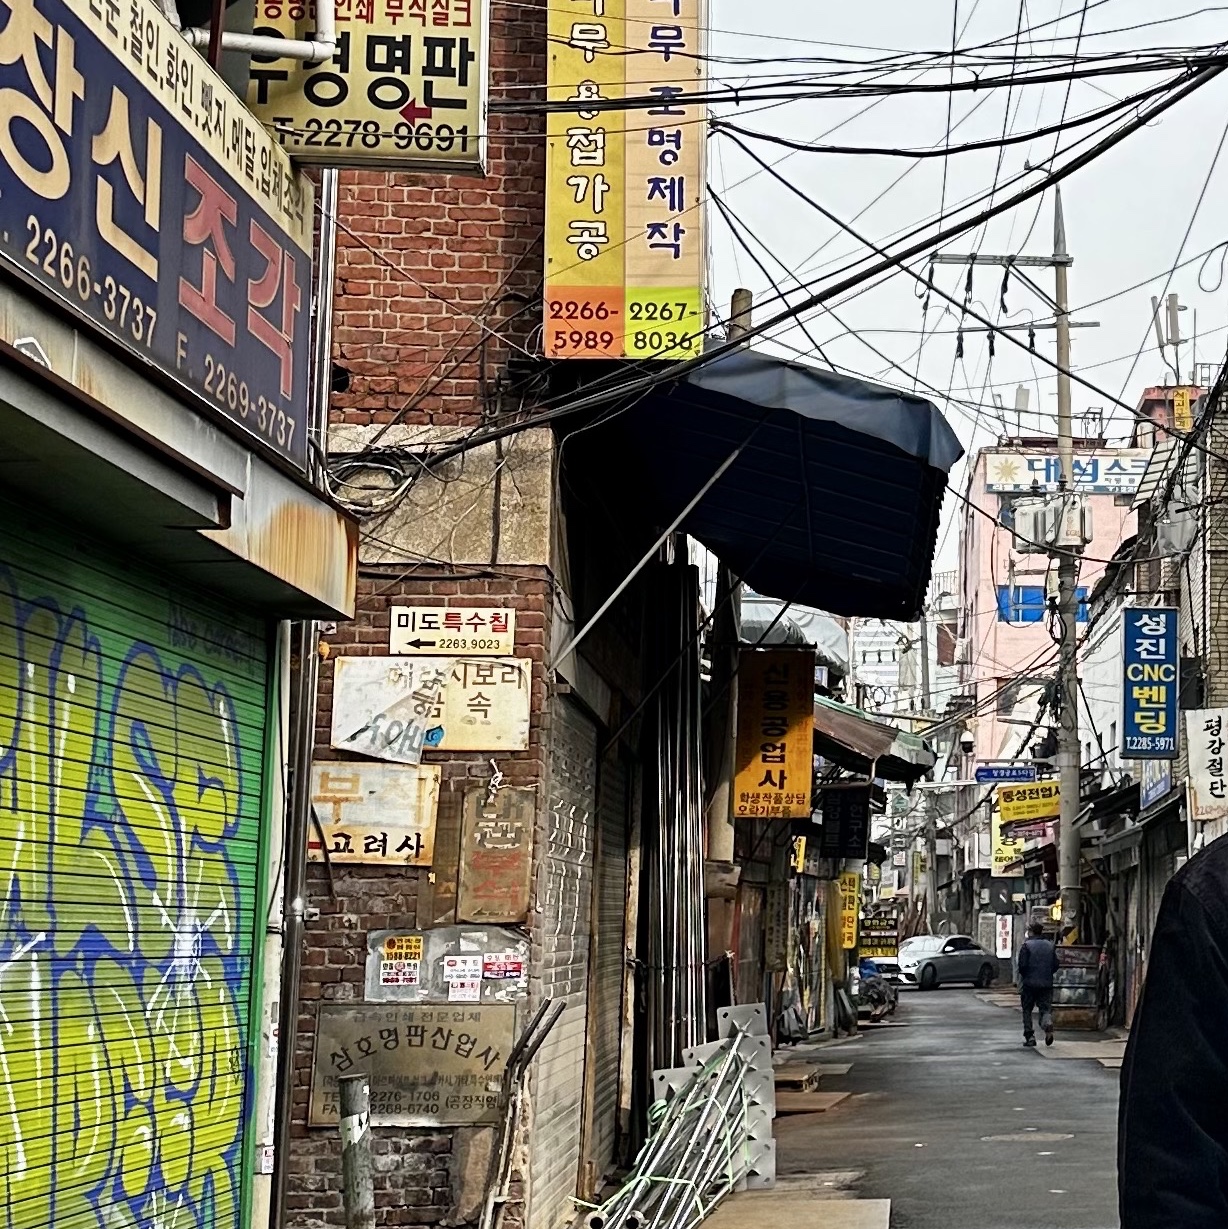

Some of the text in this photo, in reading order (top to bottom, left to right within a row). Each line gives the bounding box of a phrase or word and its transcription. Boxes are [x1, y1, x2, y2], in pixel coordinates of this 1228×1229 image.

[179, 153, 301, 400] 조각
[549, 301, 619, 320] 2266-
[629, 302, 697, 320] 2267-
[26, 215, 158, 348] 2266-3737
[204, 354, 296, 451] 2269-3737
[554, 331, 614, 349] 5989
[633, 331, 693, 349] 8036
[397, 611, 508, 633] 미도특수칠
[1134, 614, 1167, 660] 성진
[1127, 663, 1176, 682] CNC
[1132, 685, 1167, 734] 벤딩
[1203, 715, 1227, 798] 평강절단
[328, 832, 425, 859] 고려사
[330, 1024, 501, 1072] 삼호명판산업사
